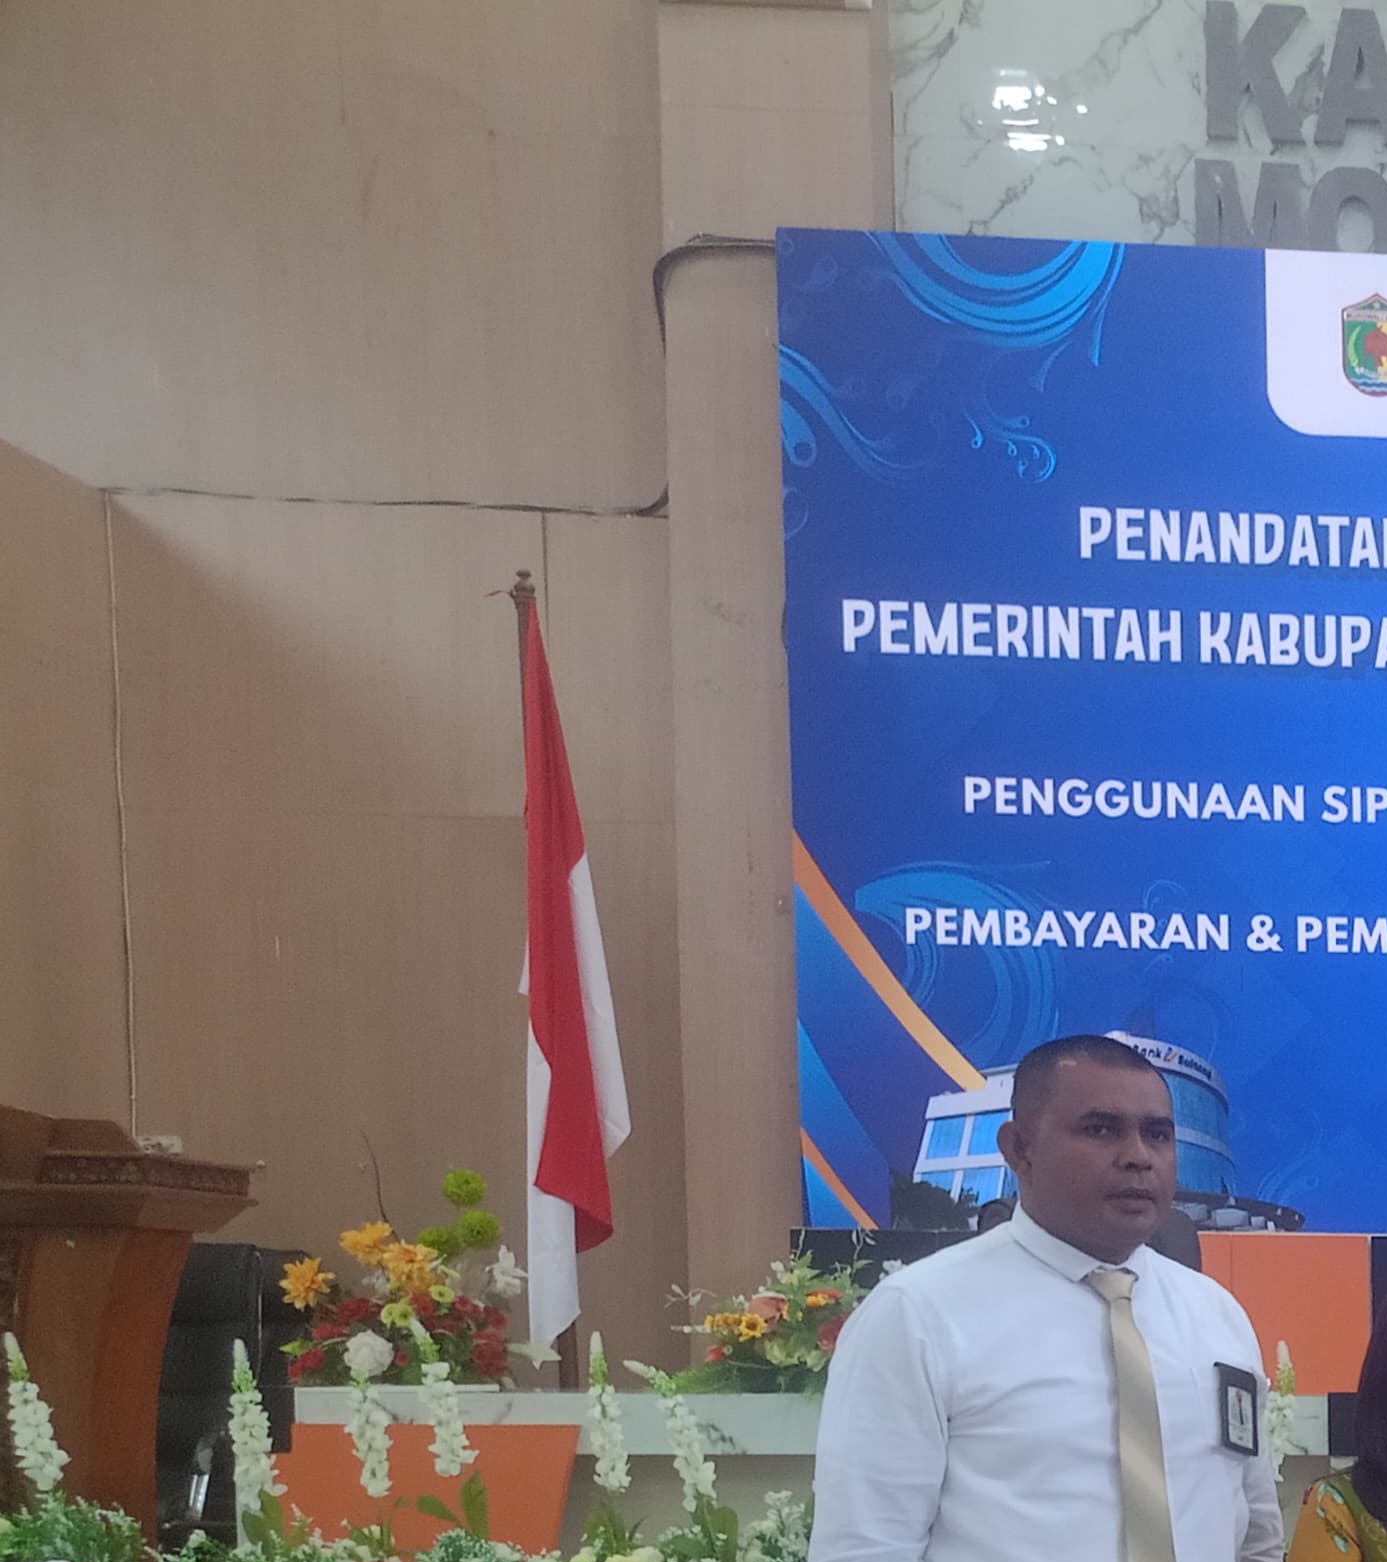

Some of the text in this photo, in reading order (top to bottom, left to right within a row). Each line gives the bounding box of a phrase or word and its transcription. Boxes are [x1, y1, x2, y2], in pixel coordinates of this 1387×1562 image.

[843, 600, 1181, 661] PEMERINTAH
[965, 777, 1304, 821] PENGGUNAAN
[906, 908, 1228, 950] PEMBAYARAN
[1247, 915, 1282, 951] &
